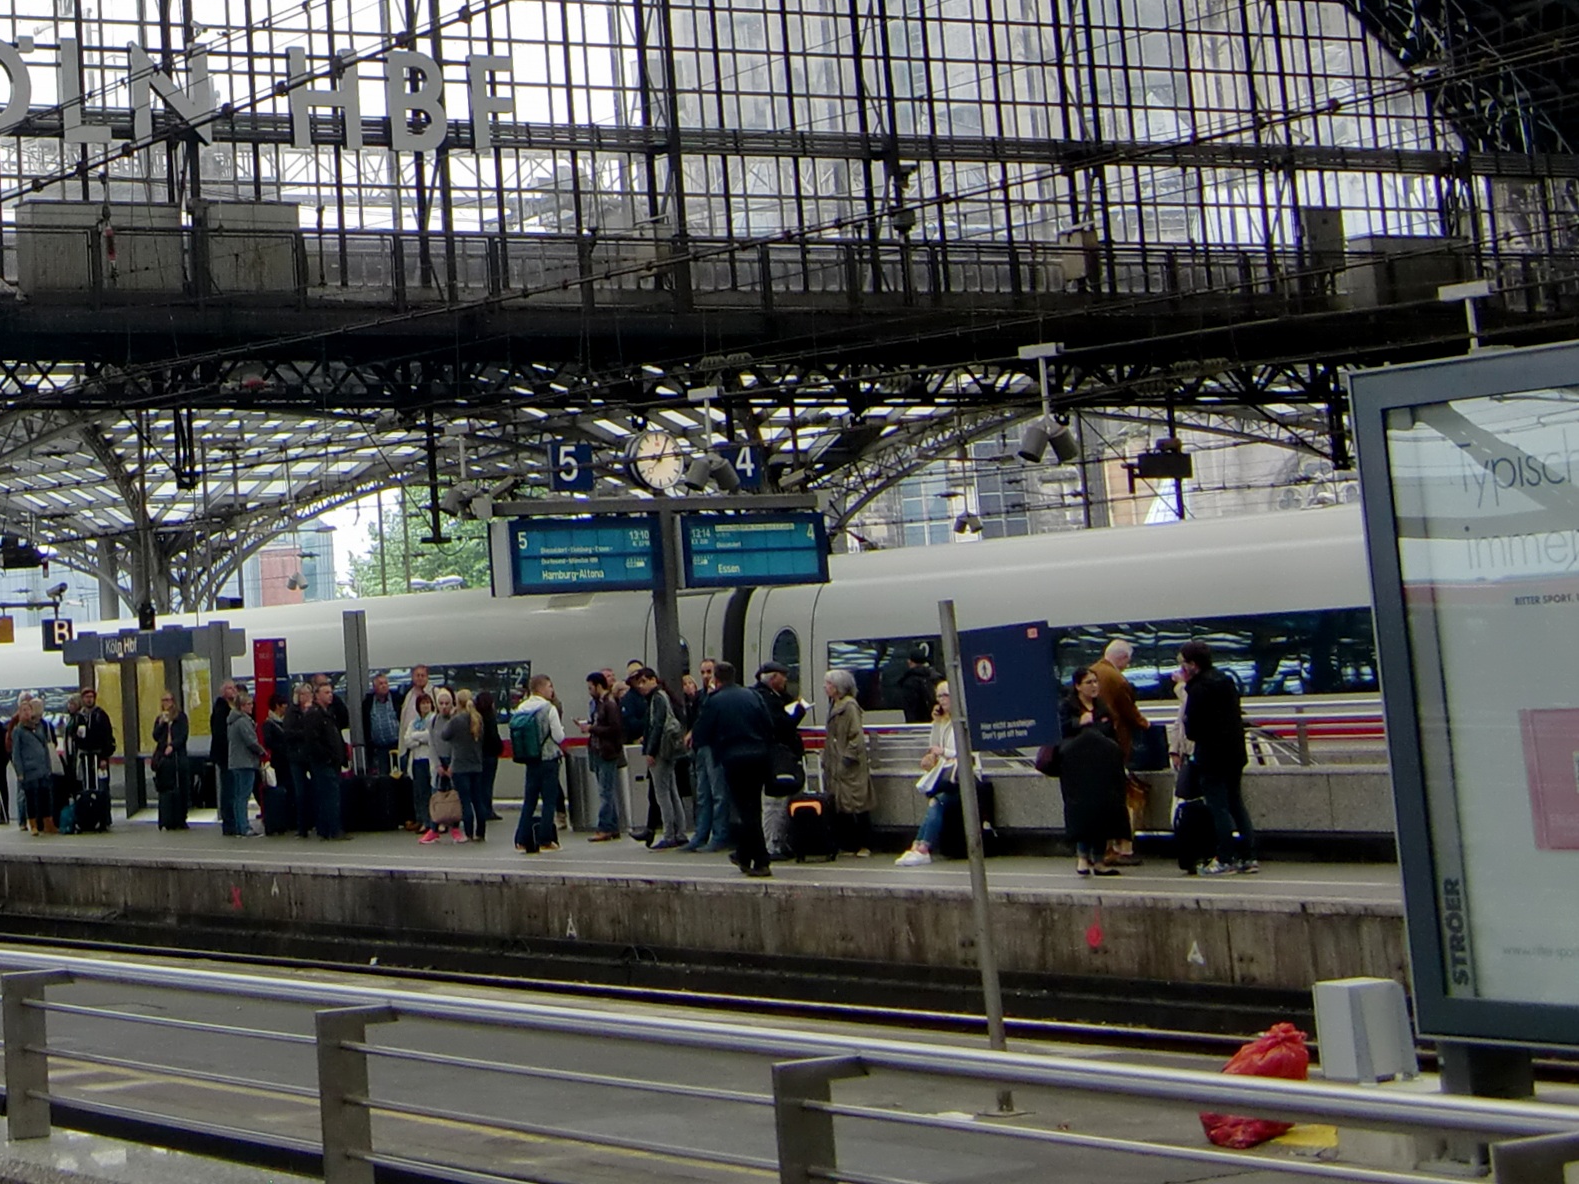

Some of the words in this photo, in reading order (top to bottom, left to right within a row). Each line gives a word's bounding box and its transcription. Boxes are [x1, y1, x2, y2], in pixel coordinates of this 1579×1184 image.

[284, 45, 517, 156] HBF
[558, 445, 580, 483] 5
[735, 445, 756, 478] 4
[517, 531, 529, 550] 5
[805, 523, 816, 541] 4
[54, 621, 70, 646] B
